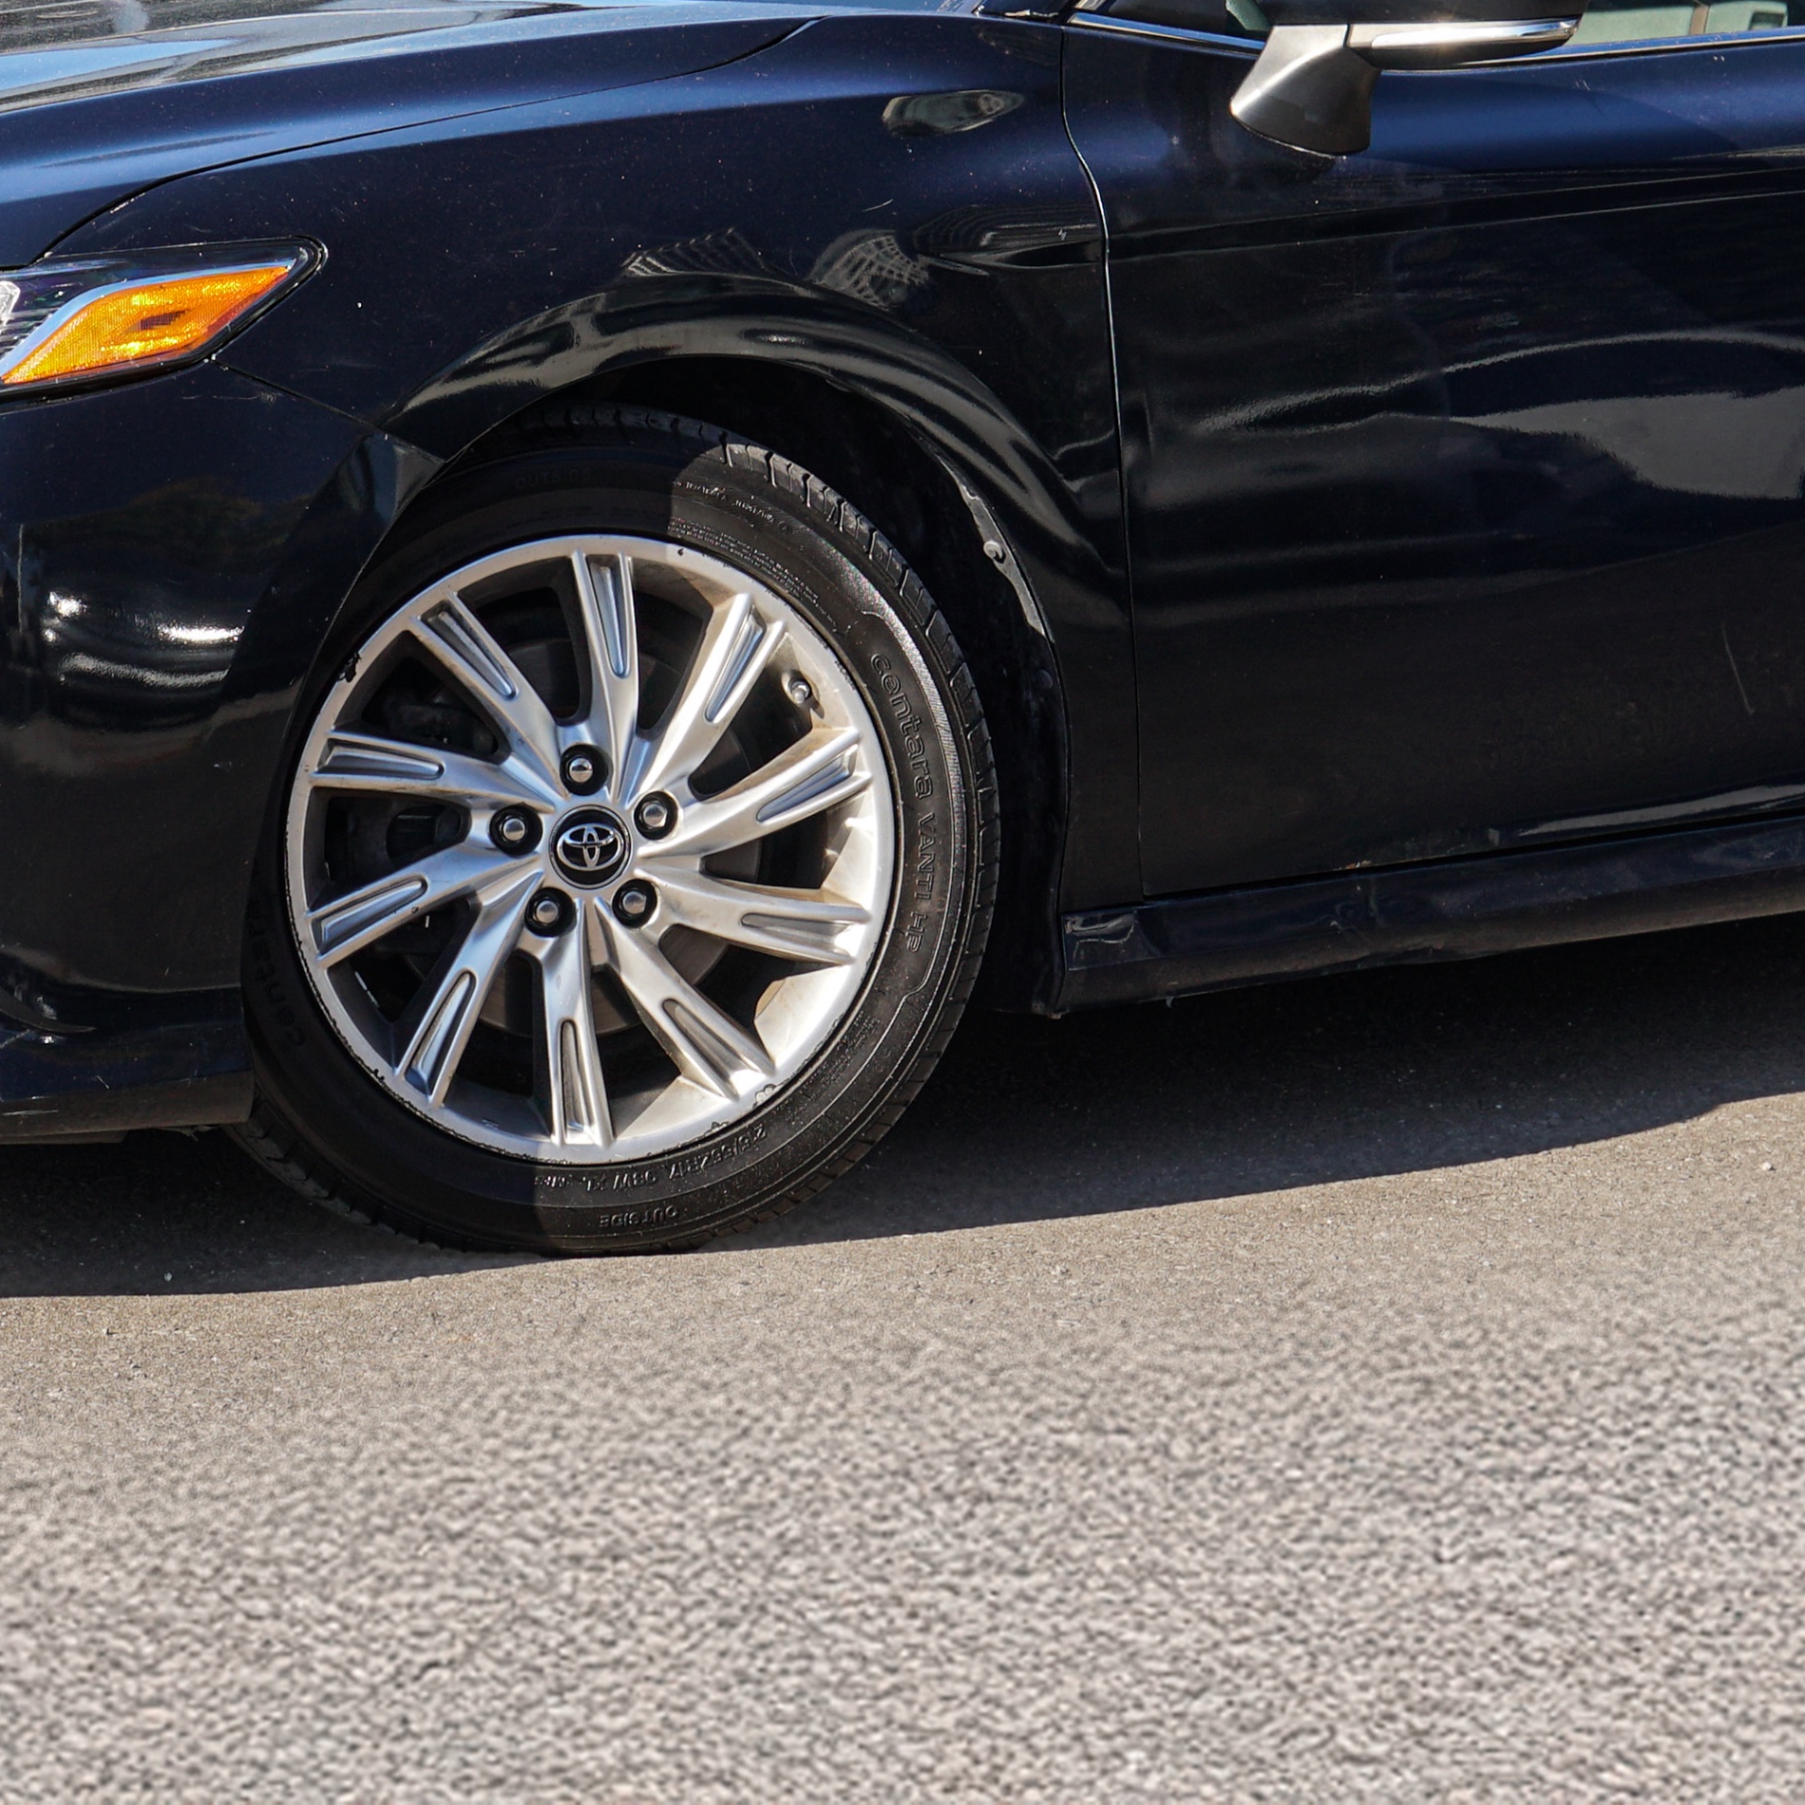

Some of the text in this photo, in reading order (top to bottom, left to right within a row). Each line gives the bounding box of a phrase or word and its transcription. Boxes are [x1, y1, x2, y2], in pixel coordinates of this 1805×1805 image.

[870, 651, 940, 955] centara VANTI HP
